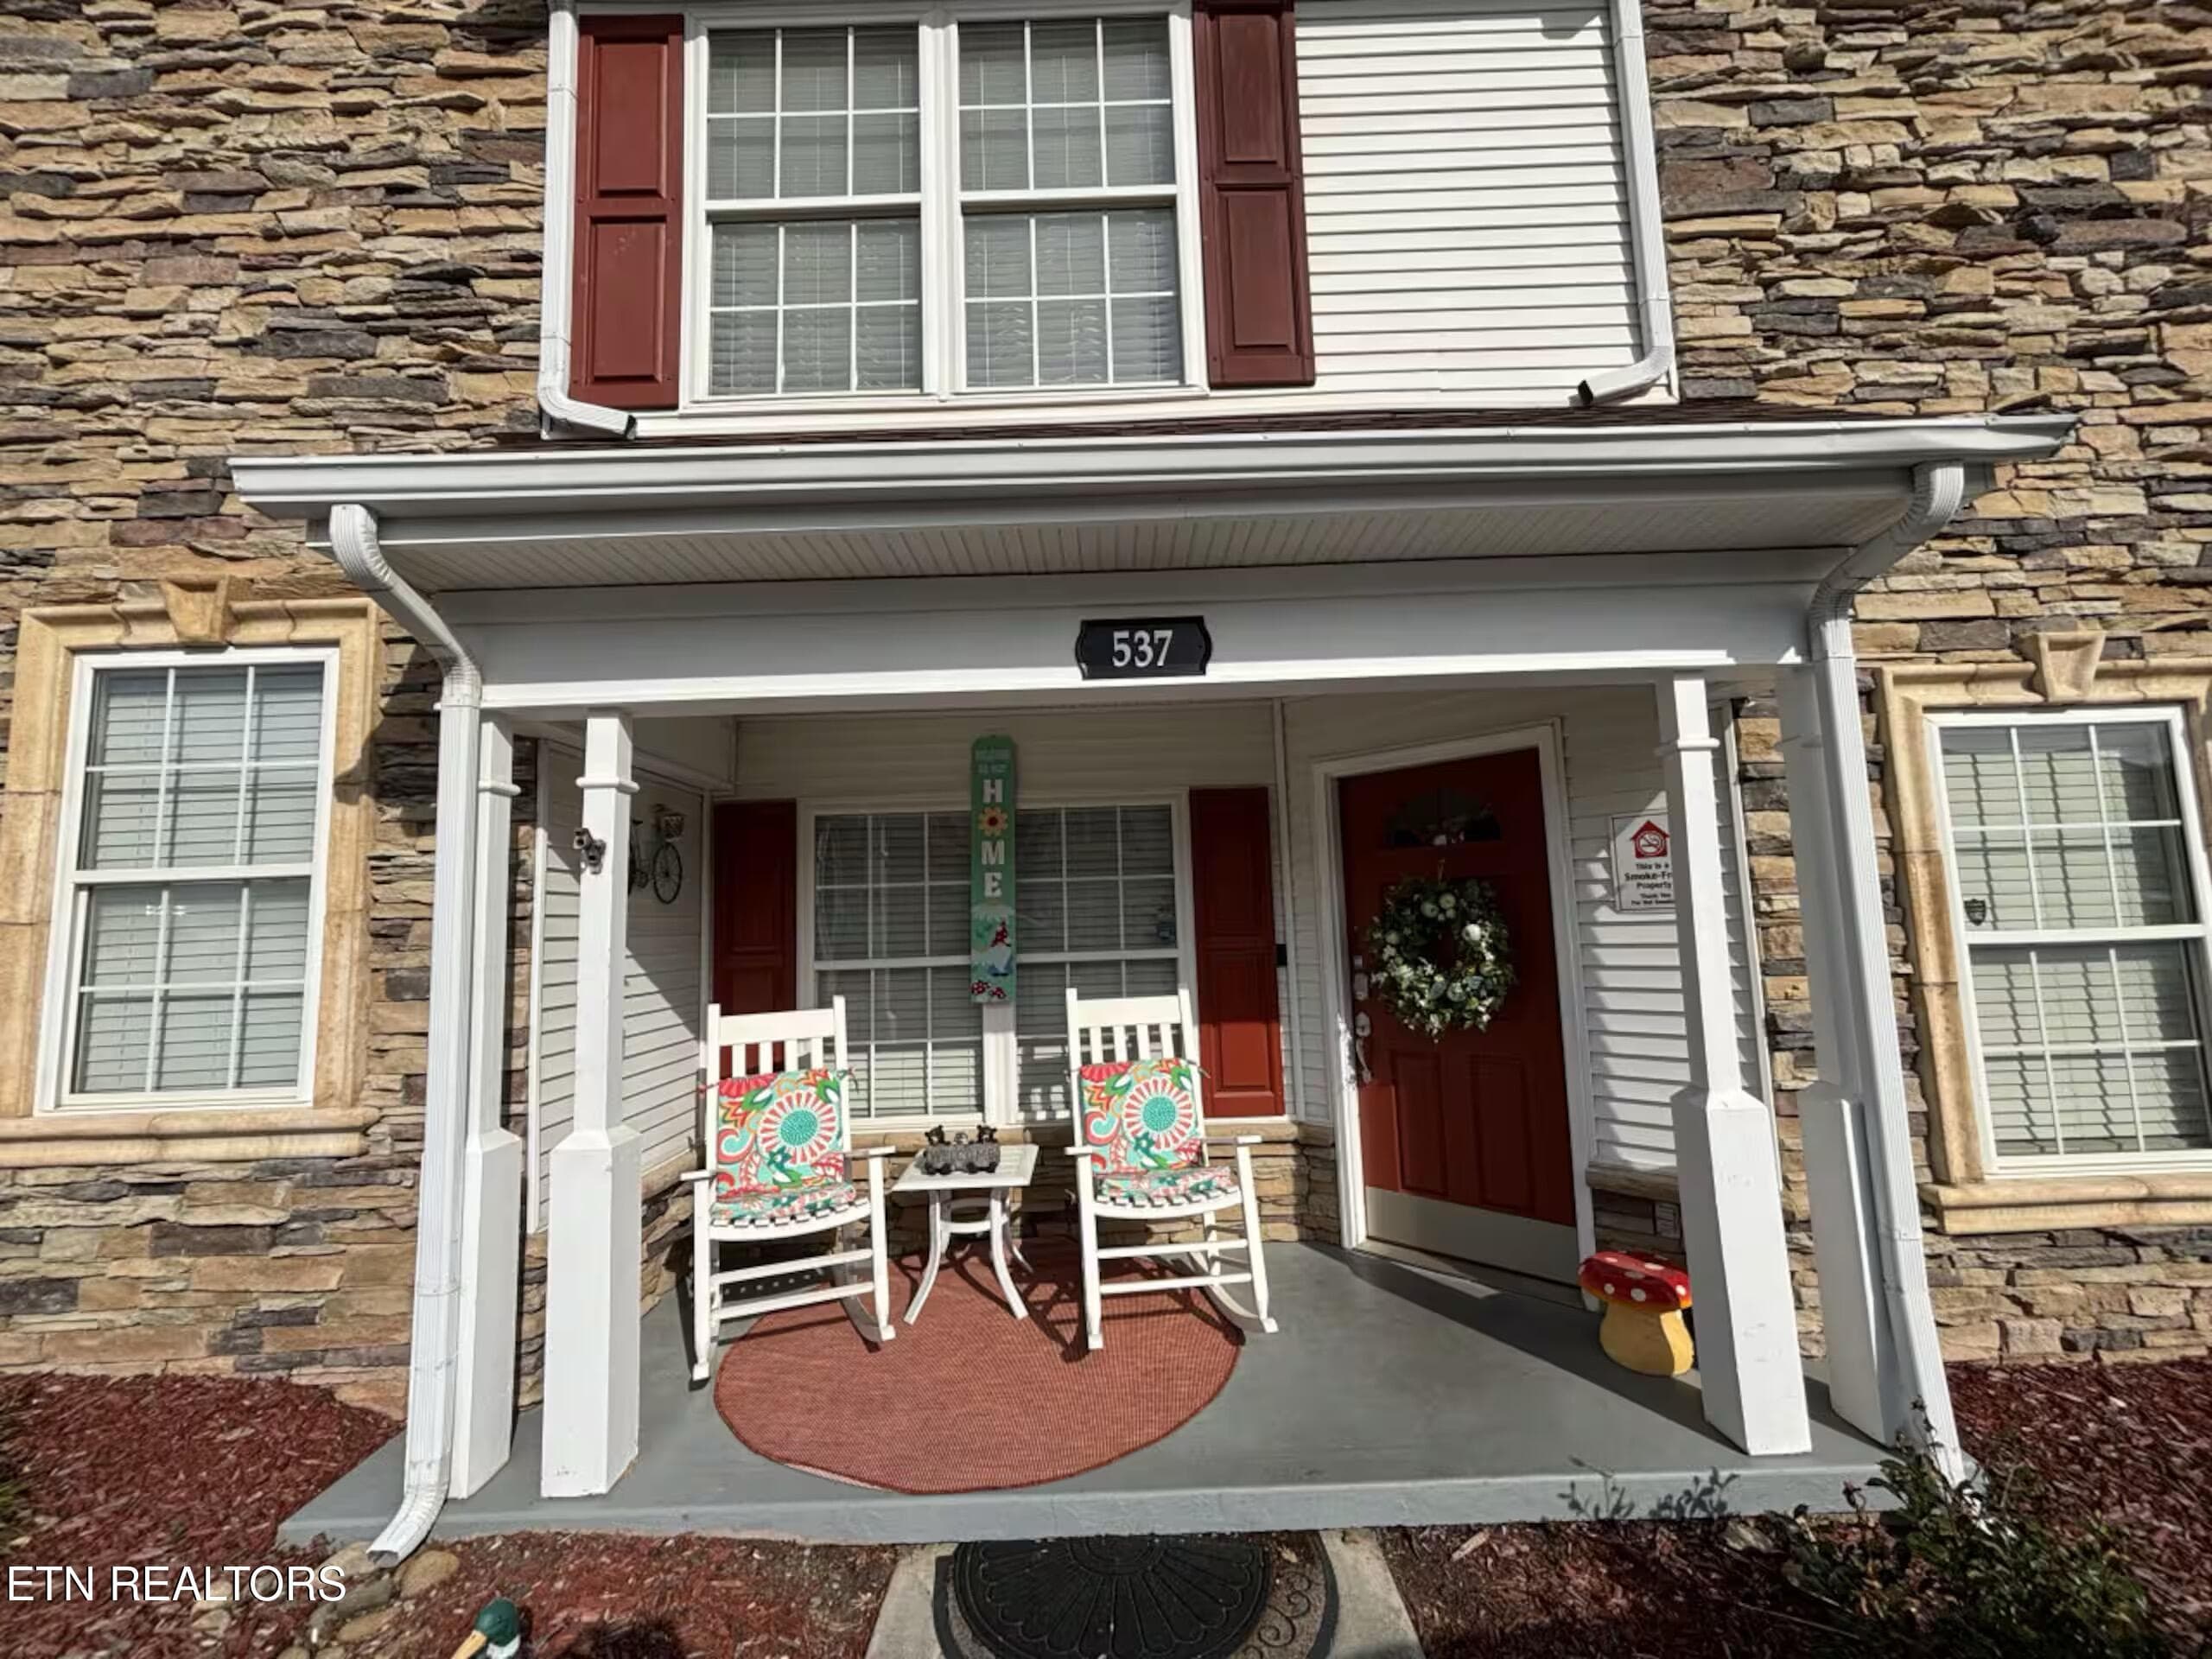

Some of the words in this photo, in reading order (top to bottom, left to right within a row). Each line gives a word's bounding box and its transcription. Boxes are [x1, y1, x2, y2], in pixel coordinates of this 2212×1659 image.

[1112, 629, 1173, 667] 537
[1624, 871, 1672, 880] Smoke-Fr
[1636, 881, 1671, 890] Property
